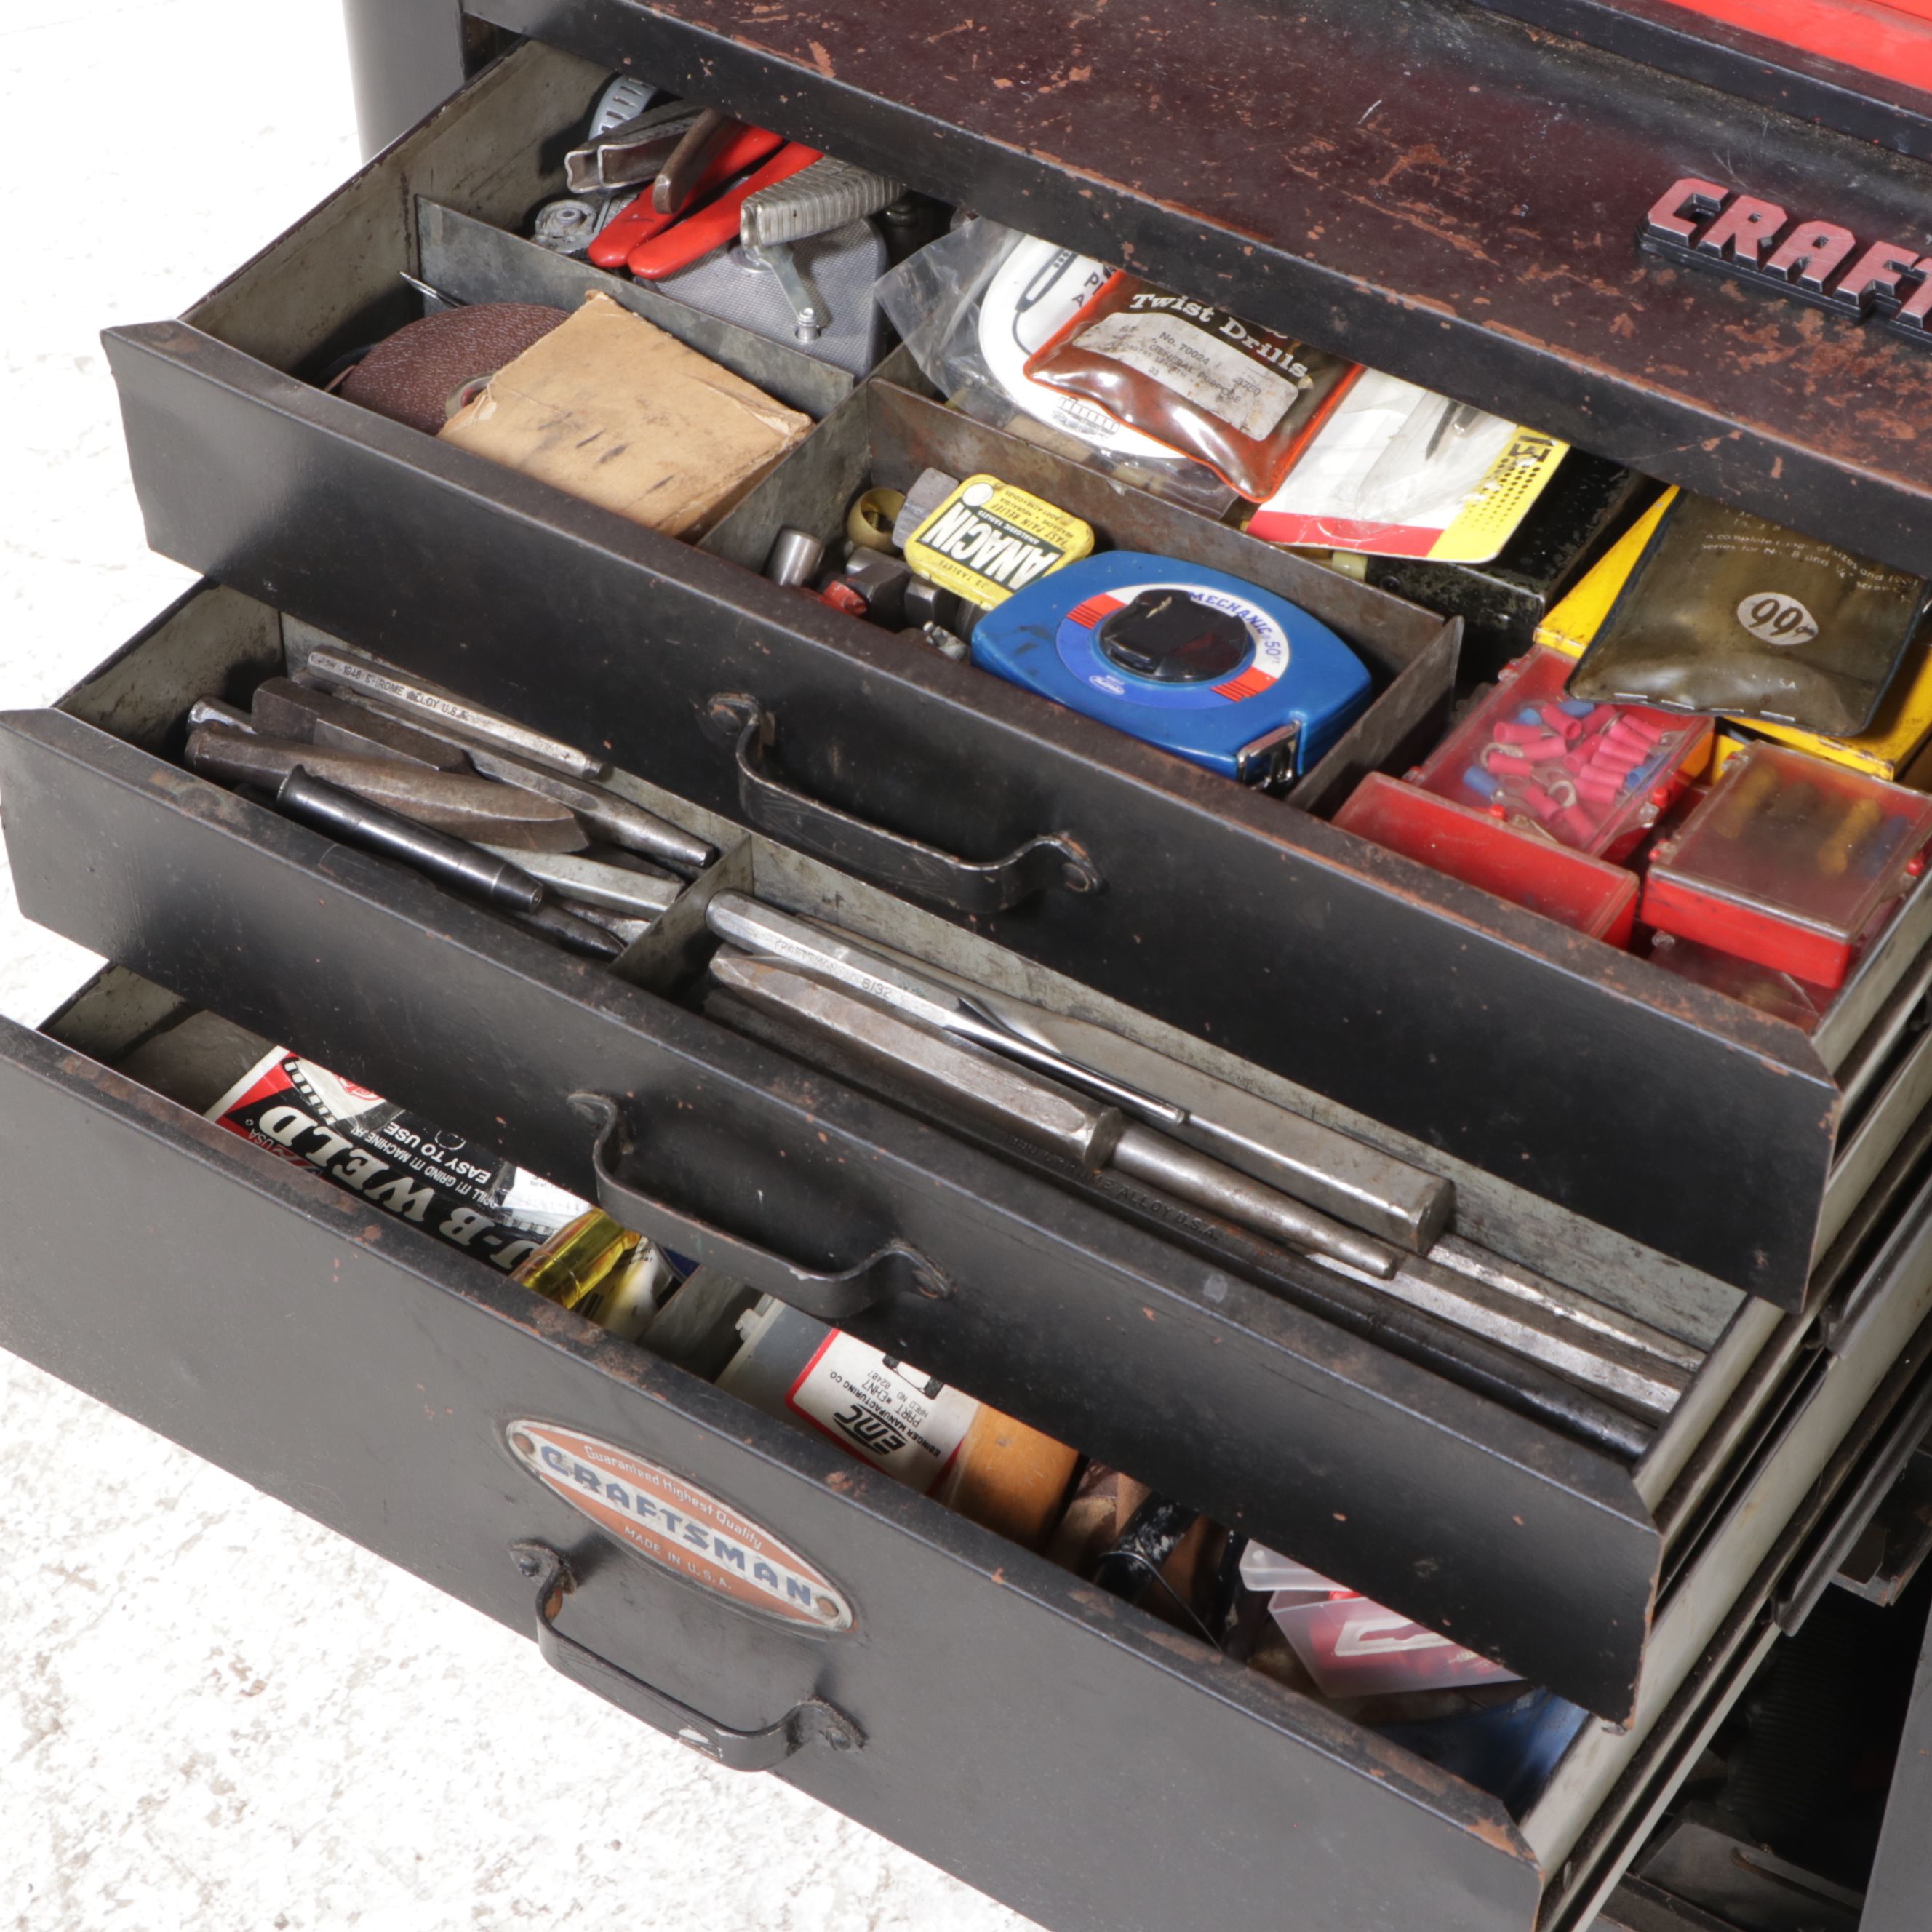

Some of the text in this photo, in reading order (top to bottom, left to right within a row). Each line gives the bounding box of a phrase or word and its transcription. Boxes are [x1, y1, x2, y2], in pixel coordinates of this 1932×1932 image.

[1131, 292, 1216, 323] Twist
[1218, 317, 1309, 380] Drills
[1159, 332, 1179, 347] No.
[1178, 343, 1211, 366] 70024
[1149, 343, 1195, 375] GENERAL
[1197, 372, 1242, 404] PURPOSE
[976, 508, 1040, 546] ANALGESIC TABLETS
[989, 503, 1069, 546] FAST PAIN RELIEF
[999, 497, 1074, 539] HEADACHE NEURALGIA
[922, 503, 1059, 590] ANACIN
[1804, 554, 1830, 567] and
[938, 559, 973, 581] TABLETS
[1188, 591, 1272, 634] MECHANIC
[364, 674, 404, 696] CHROME
[248, 1127, 274, 1150] USA
[363, 1129, 412, 1164] MACHINE
[383, 1119, 492, 1184] EASY TO USE
[408, 1155, 426, 1172] IT!
[423, 1162, 458, 1189] GRIND
[260, 1106, 542, 1272] J-B WELD
[455, 1180, 472, 1197] IT!
[1117, 1186, 1175, 1219] ALLOY
[1174, 1209, 1223, 1243] U.S.A.
[866, 1369, 891, 1390] 02407
[896, 1391, 908, 1402] NO
[828, 1369, 941, 1457] EBINGER MANUFACTURING CO.
[894, 1403, 922, 1427] PART
[584, 1445, 762, 1550] Guaranteed Highest Quality
[540, 1445, 812, 1607] CRAFTSMAN
[624, 1526, 733, 1589] MADE IN U.S.A.
